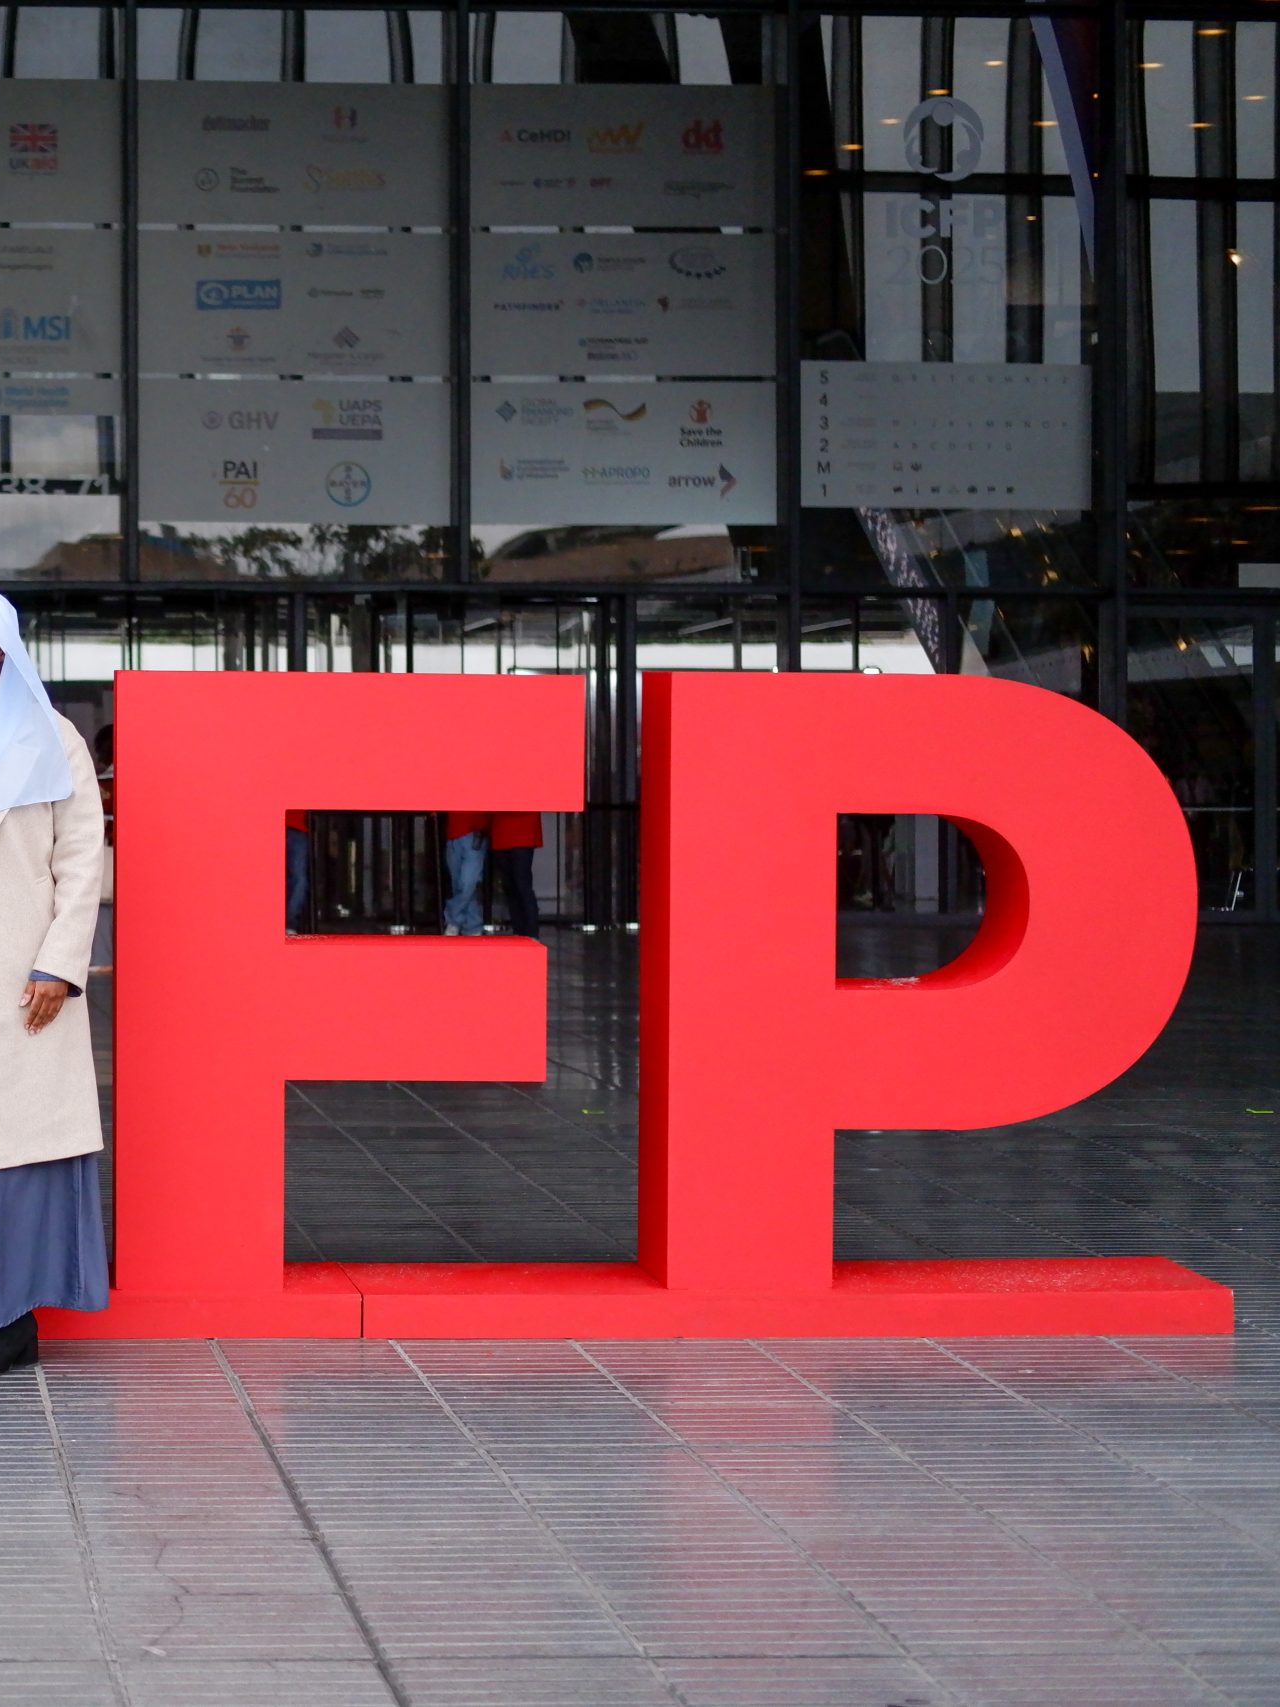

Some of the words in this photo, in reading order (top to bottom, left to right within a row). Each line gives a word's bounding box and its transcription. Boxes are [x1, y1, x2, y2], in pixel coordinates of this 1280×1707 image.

[517, 128, 571, 143] CeHDI
[885, 199, 1004, 238] ICFP
[886, 245, 1004, 285] 2025
[231, 285, 279, 299] PLAN
[23, 315, 72, 341] MSI
[819, 370, 829, 384] 5
[339, 400, 383, 412] UAPS
[819, 393, 828, 407] 4
[228, 412, 280, 430] GHV
[339, 414, 383, 426] UEPA
[820, 416, 829, 430] 3
[680, 427, 704, 436] Save
[706, 427, 722, 436] the
[680, 438, 723, 447] Children
[819, 438, 829, 452] 2
[223, 461, 258, 479] PAI
[817, 461, 831, 474] M
[668, 476, 715, 488] arrow
[821, 484, 827, 496] 1
[223, 487, 257, 509] 60
